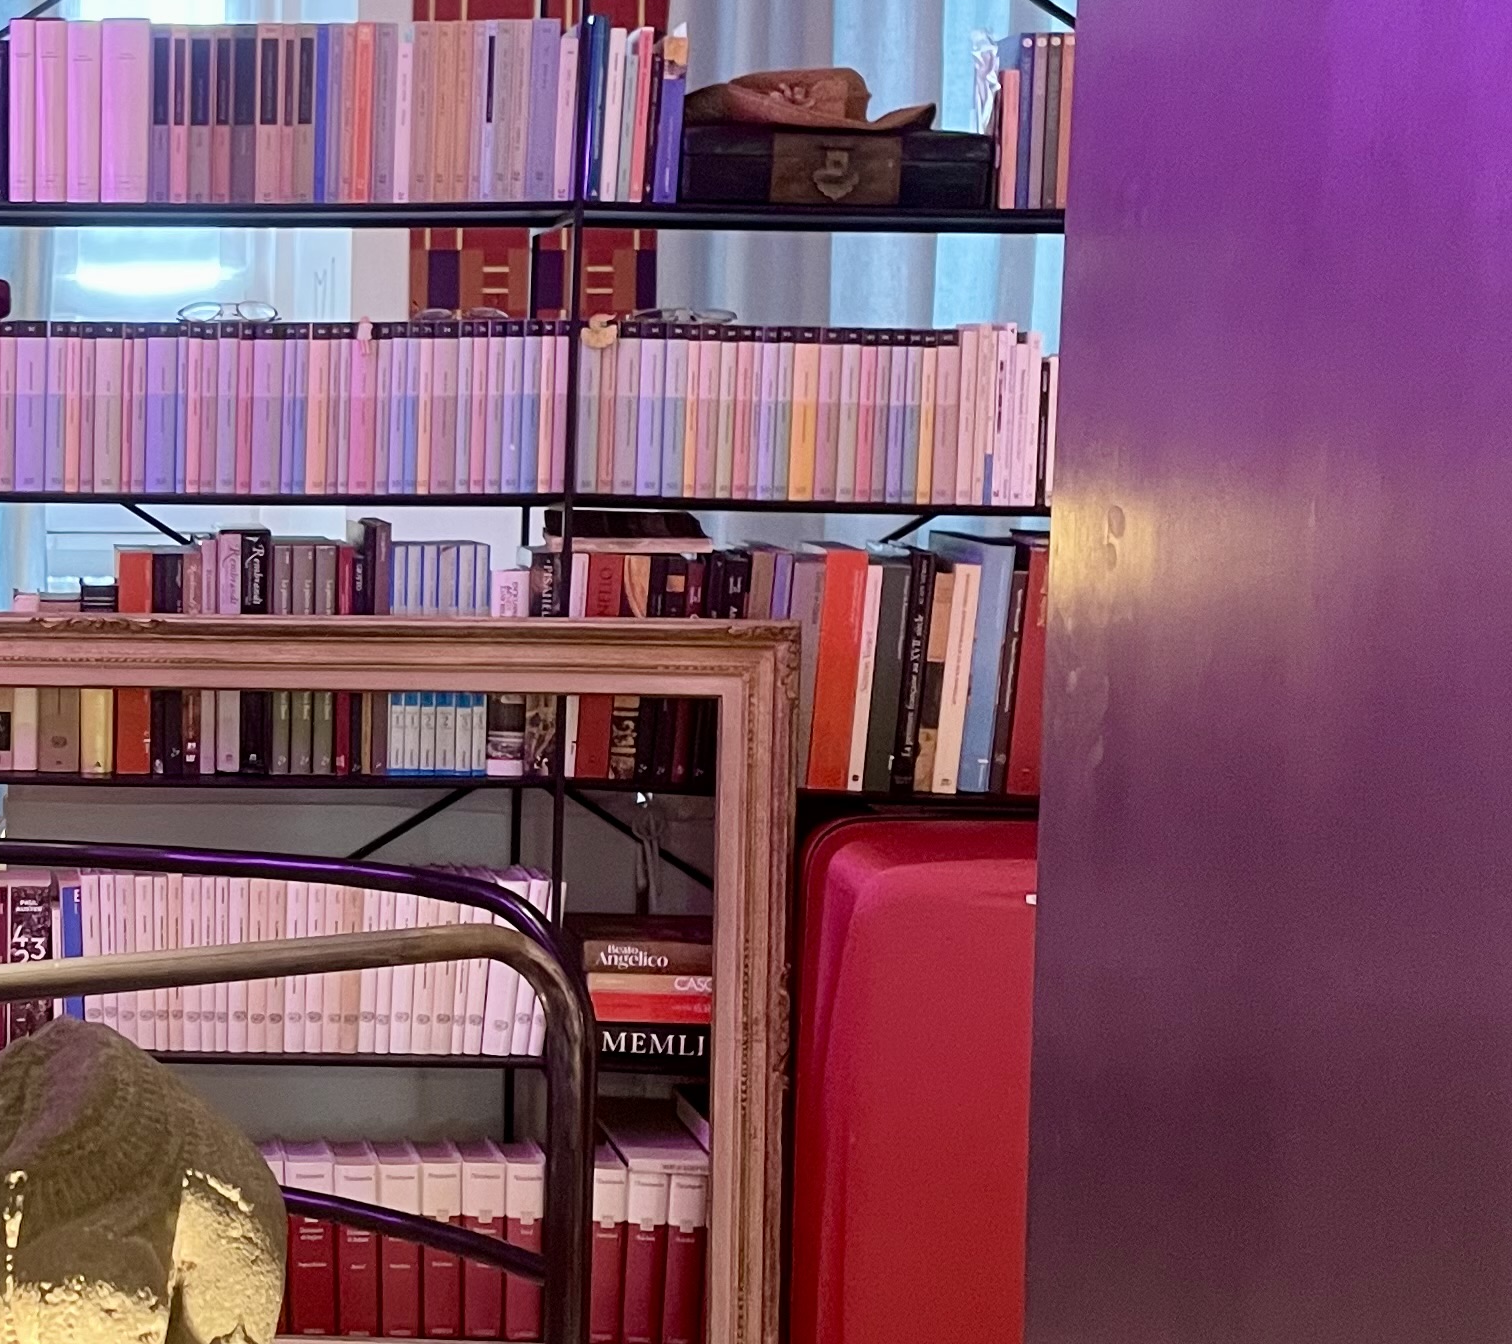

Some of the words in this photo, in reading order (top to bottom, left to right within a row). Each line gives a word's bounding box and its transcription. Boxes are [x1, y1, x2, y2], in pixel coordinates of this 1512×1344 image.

[221, 544, 241, 605] Rembrandt
[244, 544, 265, 605] Rembrandt
[900, 746, 912, 757] La
[12, 925, 28, 948] 4
[30, 937, 46, 961] 3
[607, 944, 639, 954] Beato
[596, 950, 669, 970] Angelico
